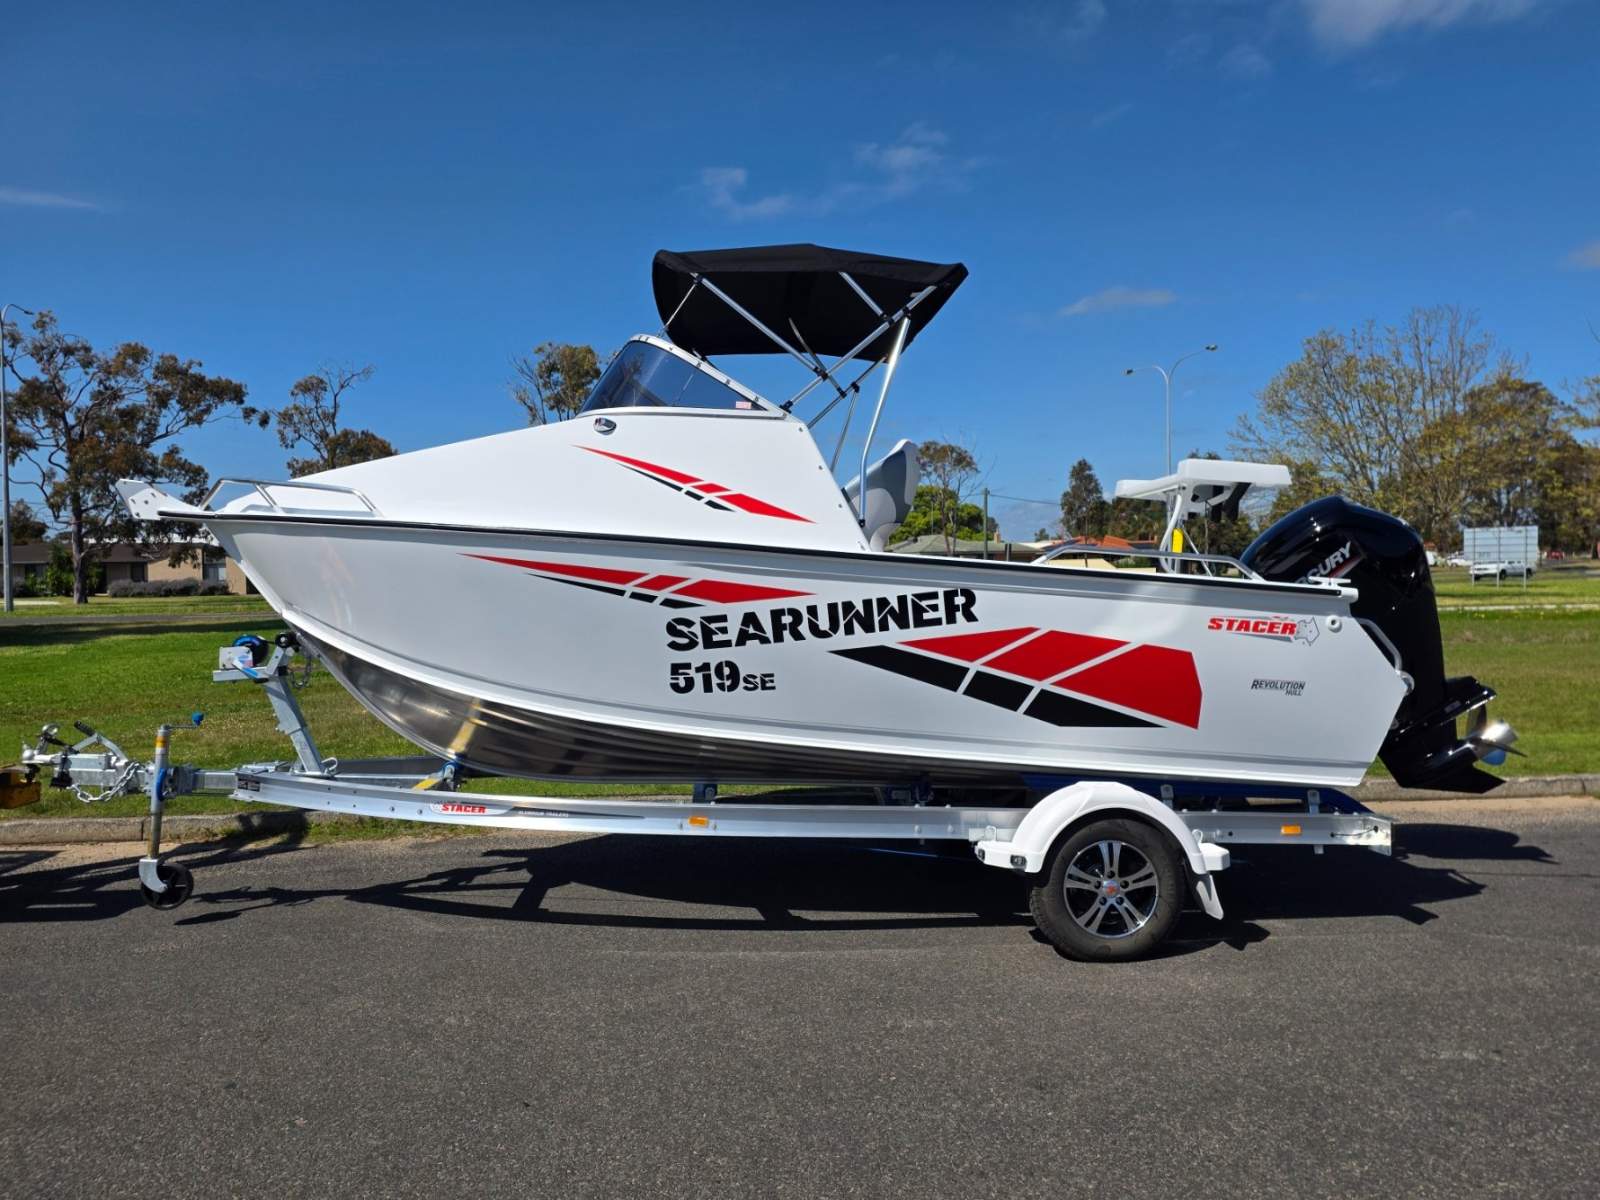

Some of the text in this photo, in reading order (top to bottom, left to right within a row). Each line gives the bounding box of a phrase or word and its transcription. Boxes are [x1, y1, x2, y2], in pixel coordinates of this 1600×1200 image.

[665, 588, 979, 652] SEARUNNER
[1207, 617, 1297, 636] STACER
[1250, 679, 1306, 690] REVOLUTION
[441, 803, 487, 814] STACER
